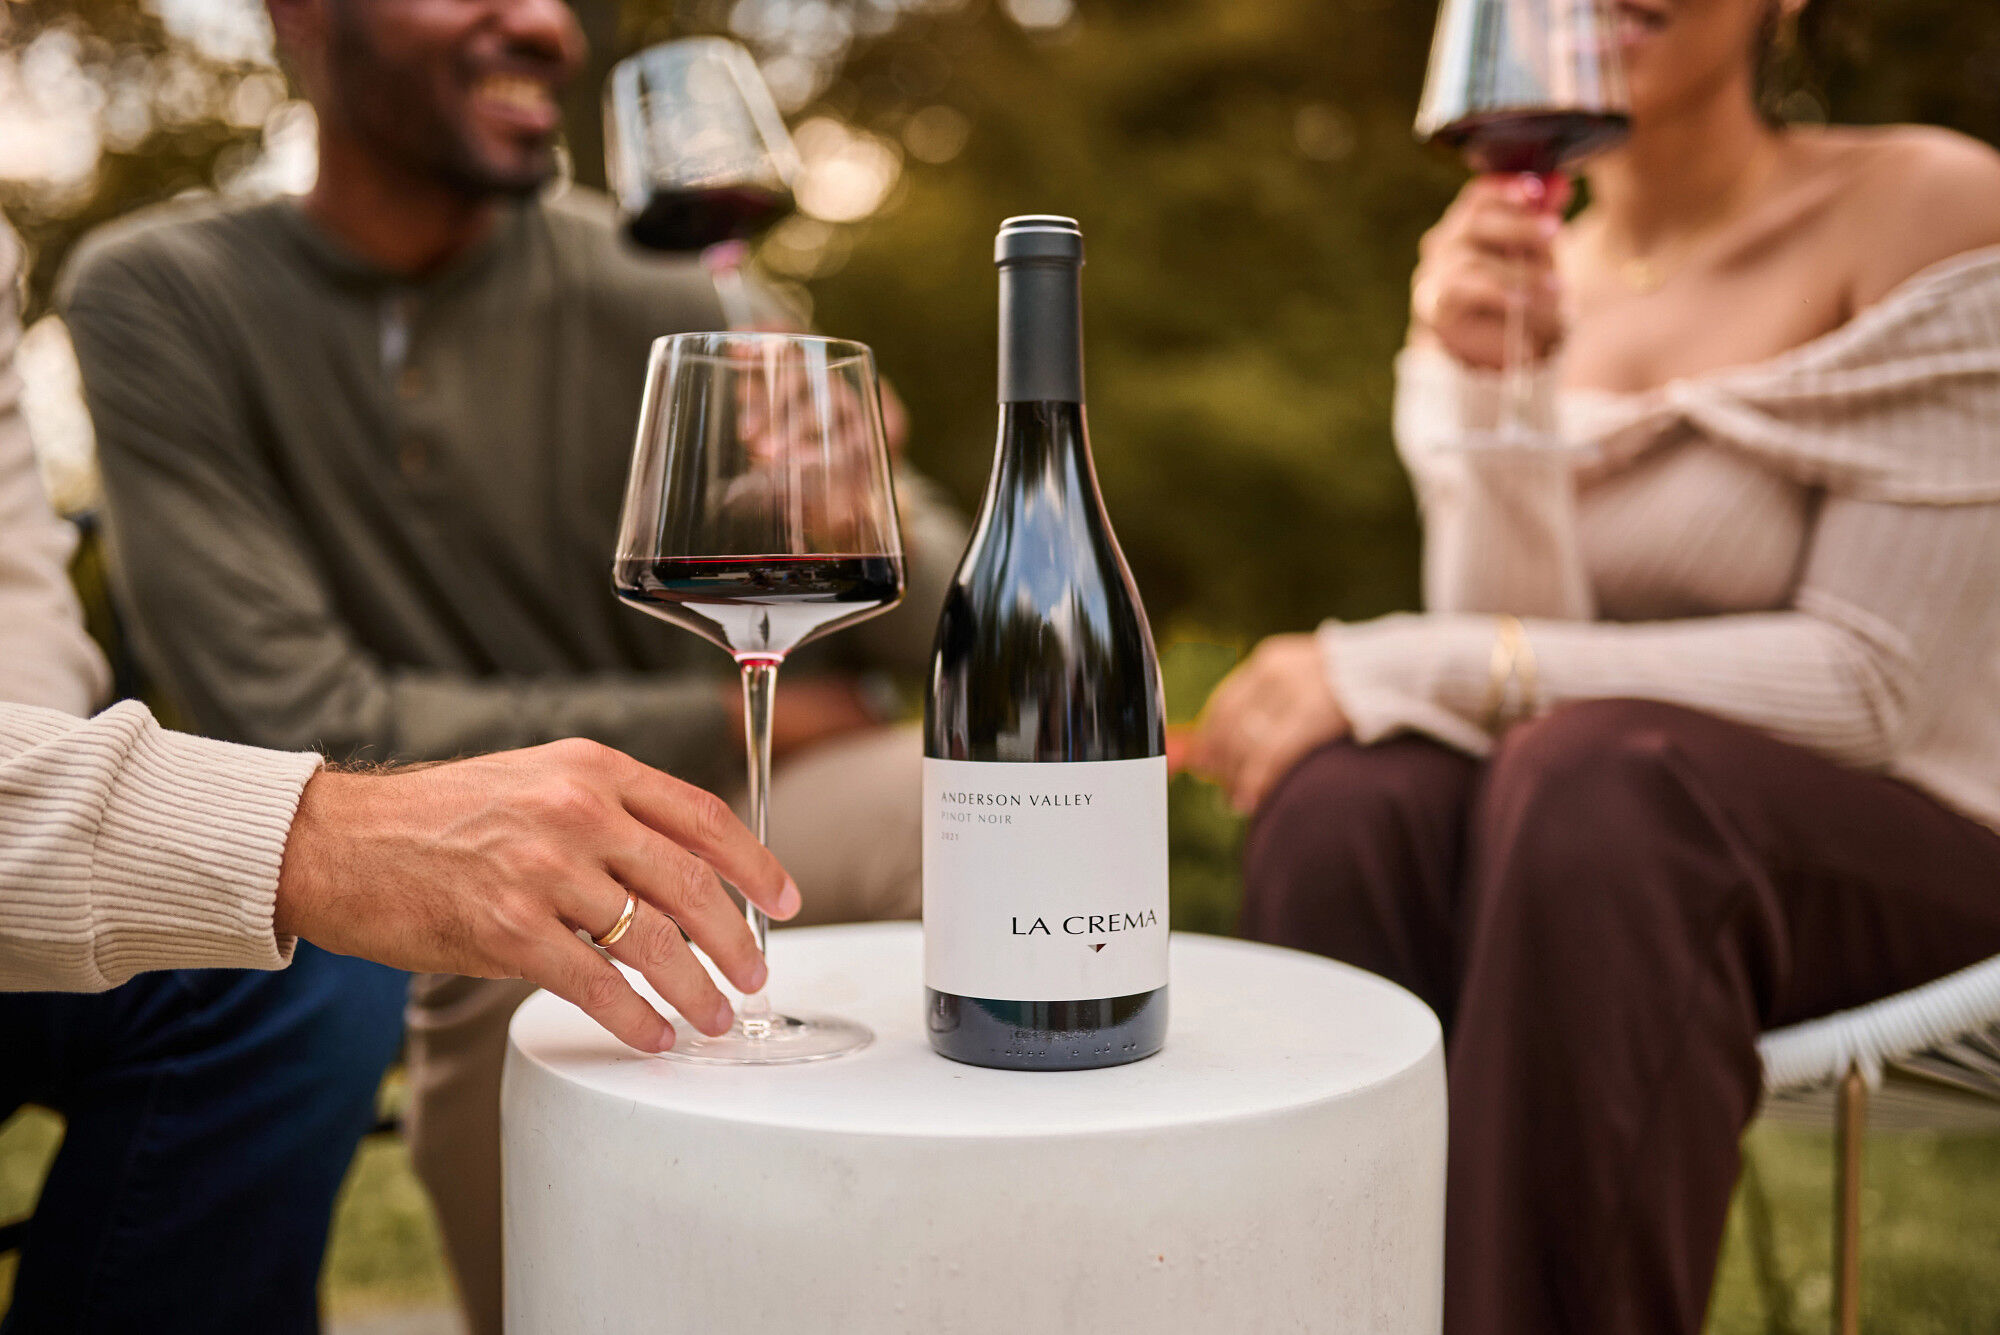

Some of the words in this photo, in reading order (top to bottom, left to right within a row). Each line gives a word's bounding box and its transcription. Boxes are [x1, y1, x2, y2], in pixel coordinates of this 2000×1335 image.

[941, 791, 1021, 806] ANDERSON
[1029, 794, 1093, 806] VALLEY
[941, 811, 971, 823] PINOT
[978, 814, 1012, 825] NOIR
[1012, 917, 1051, 935] LA
[1062, 909, 1157, 935] CREMA
